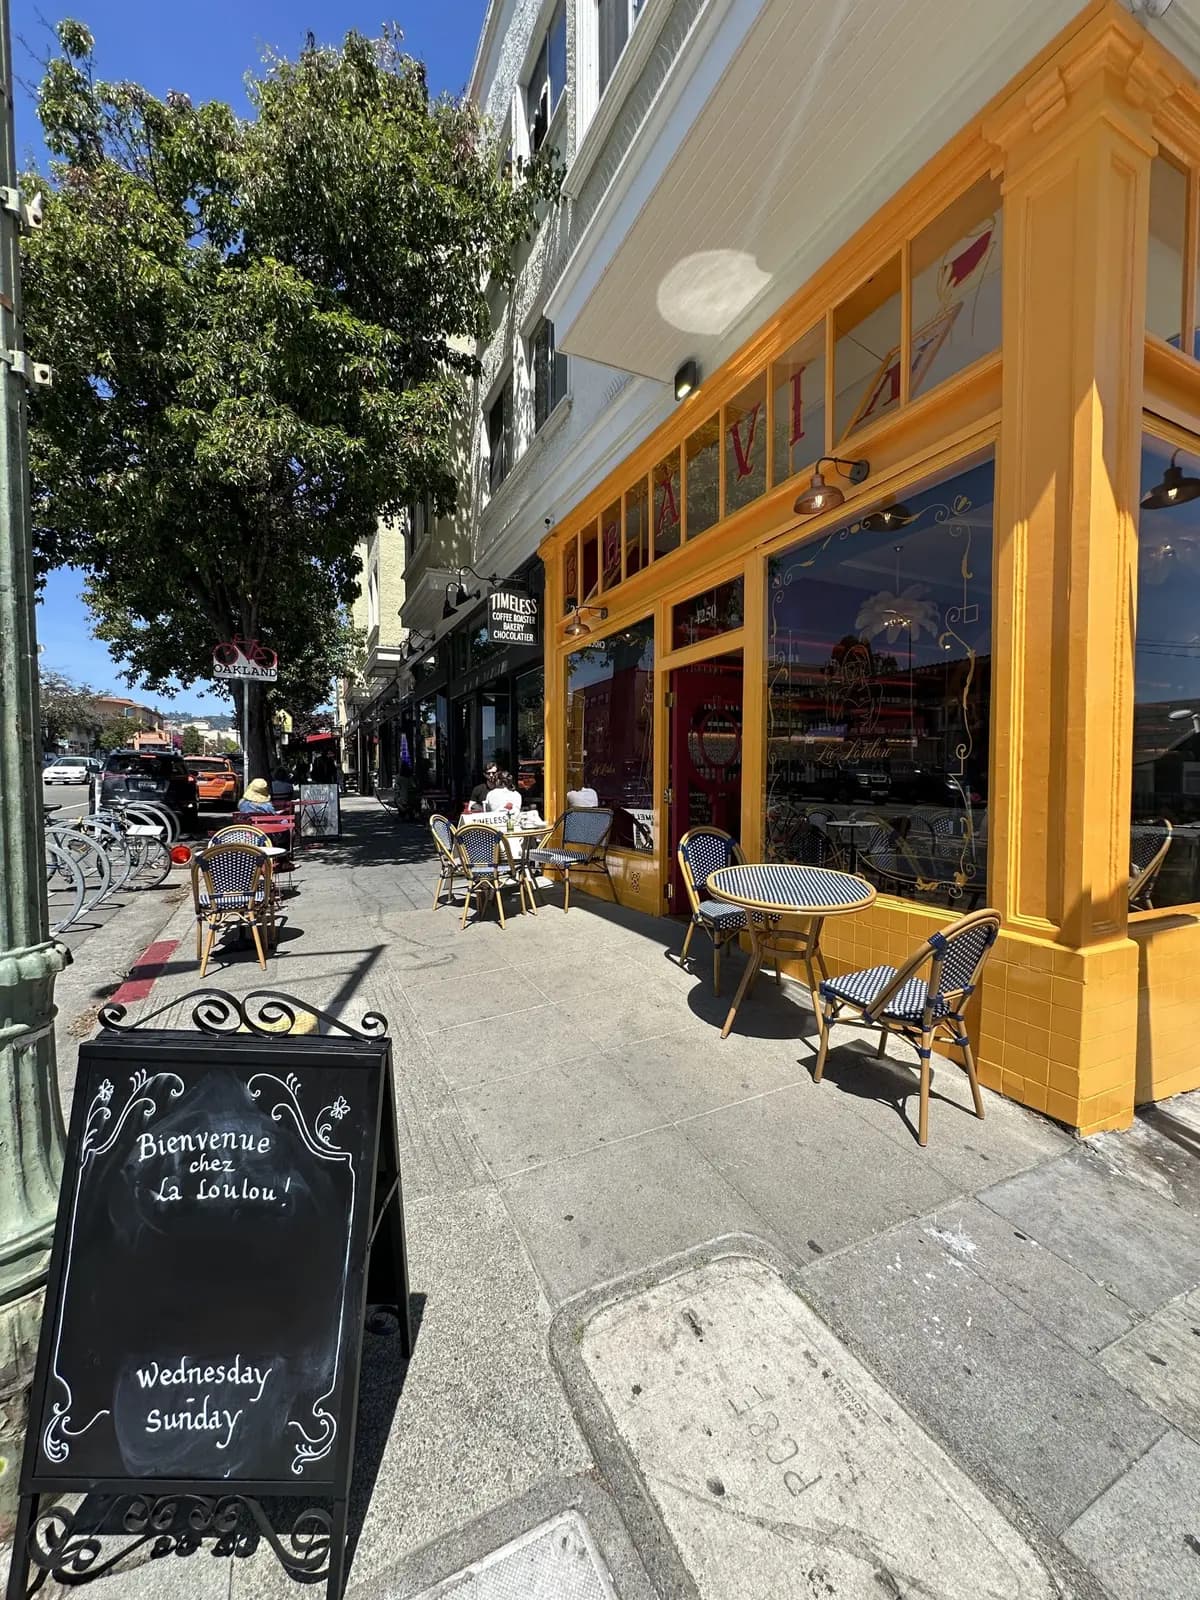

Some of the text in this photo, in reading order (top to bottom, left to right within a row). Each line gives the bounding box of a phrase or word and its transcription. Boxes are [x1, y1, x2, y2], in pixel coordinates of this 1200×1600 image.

[489, 592, 537, 615] TIMELESS
[492, 612, 536, 625] COFFEE ROASTER
[503, 622, 525, 632] BAKERY
[493, 630, 534, 642] CHOCOLATIER
[213, 663, 277, 677] OAKLAND
[136, 1131, 271, 1162] Bienvenue
[189, 1155, 236, 1173] chez
[155, 1177, 183, 1202] La
[136, 1353, 273, 1402] Wednesday
[819, 1371, 860, 1420] CHRIST
[145, 1395, 243, 1449] Sunday
